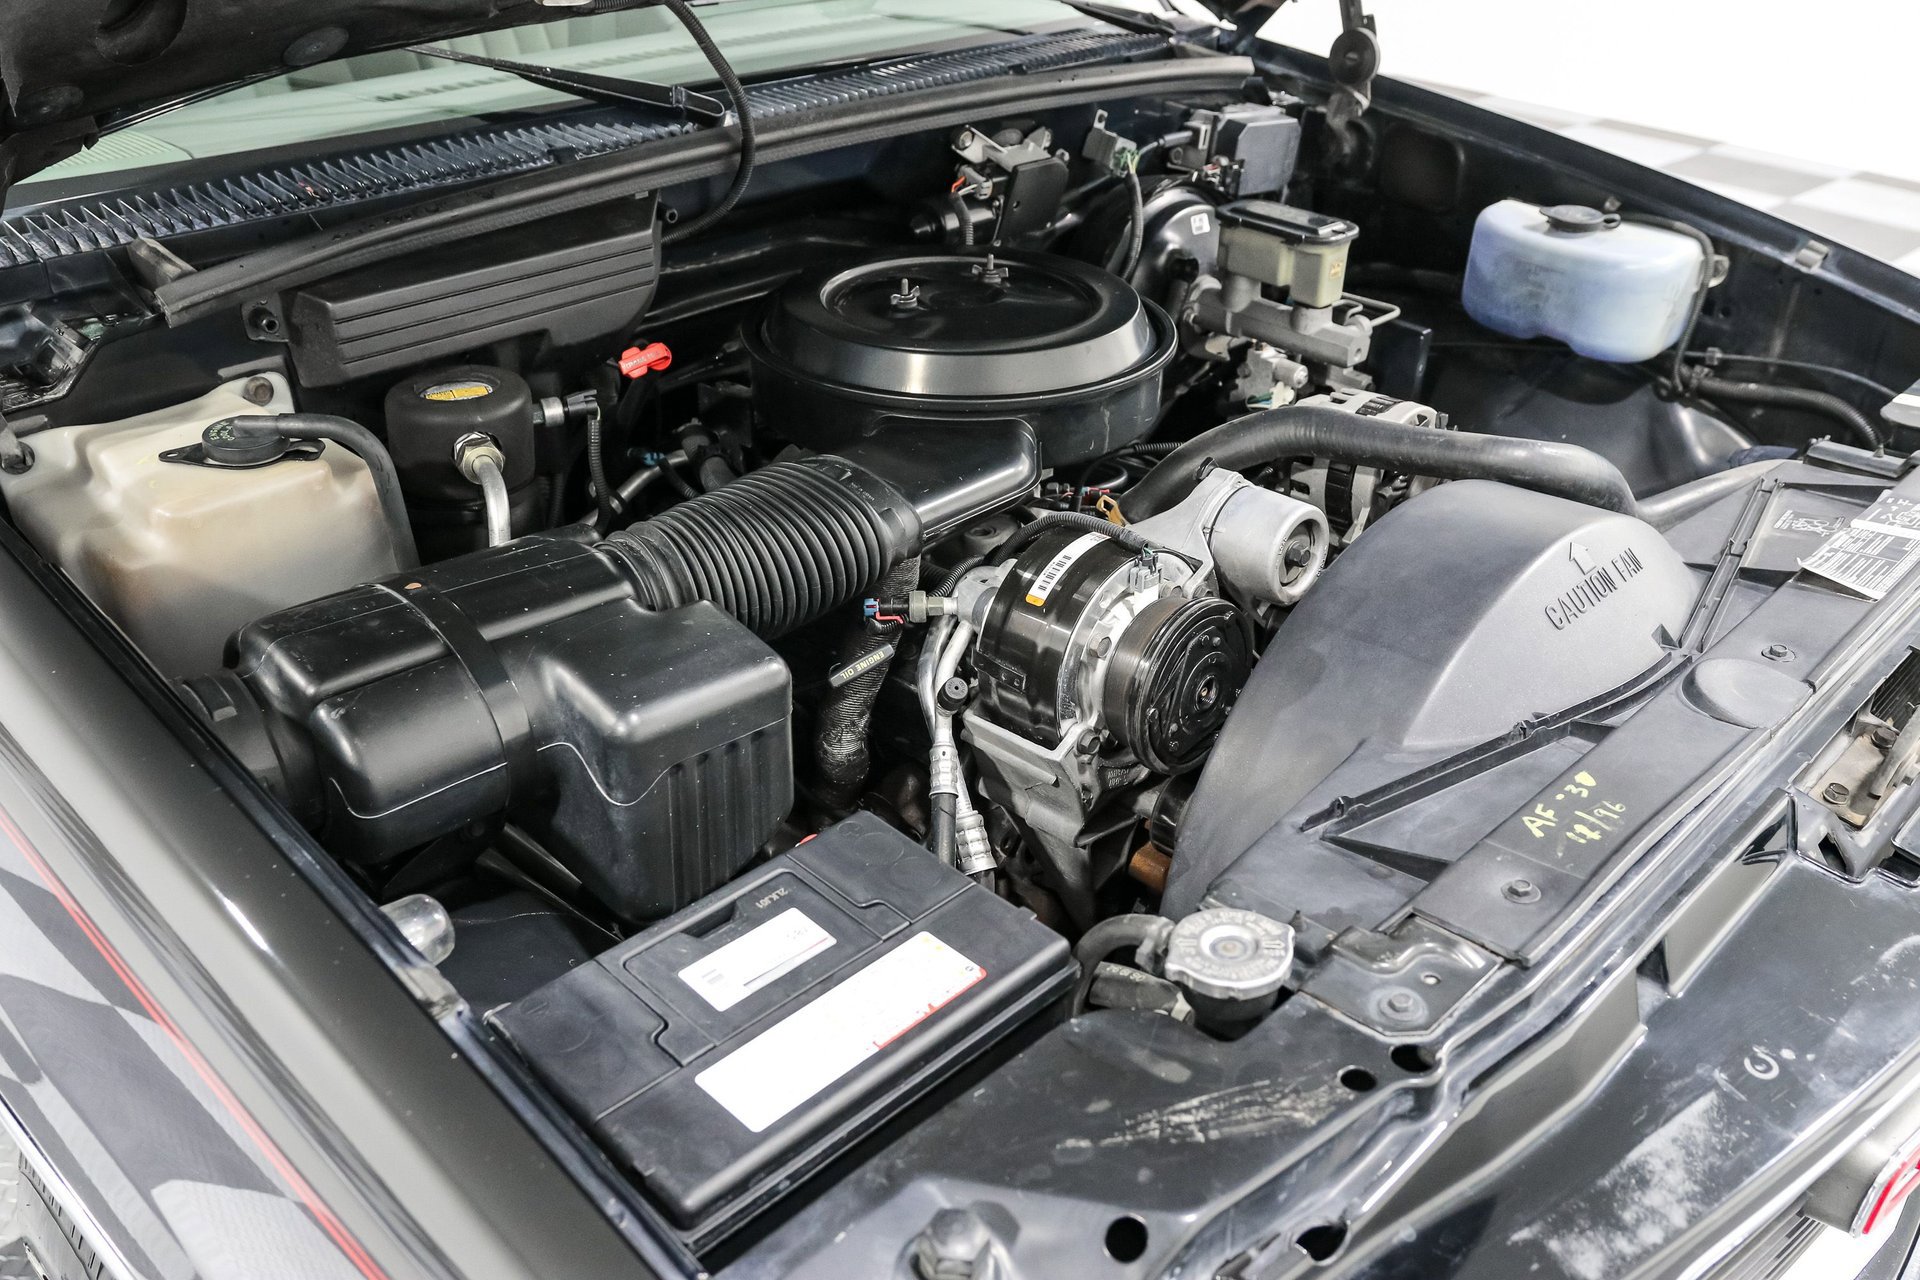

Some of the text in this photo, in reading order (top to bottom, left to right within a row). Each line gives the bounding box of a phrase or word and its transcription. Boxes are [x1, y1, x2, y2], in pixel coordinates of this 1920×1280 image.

[1545, 547, 1643, 631] CAUTION FAN
[840, 651, 885, 679] ENGINE OIL
